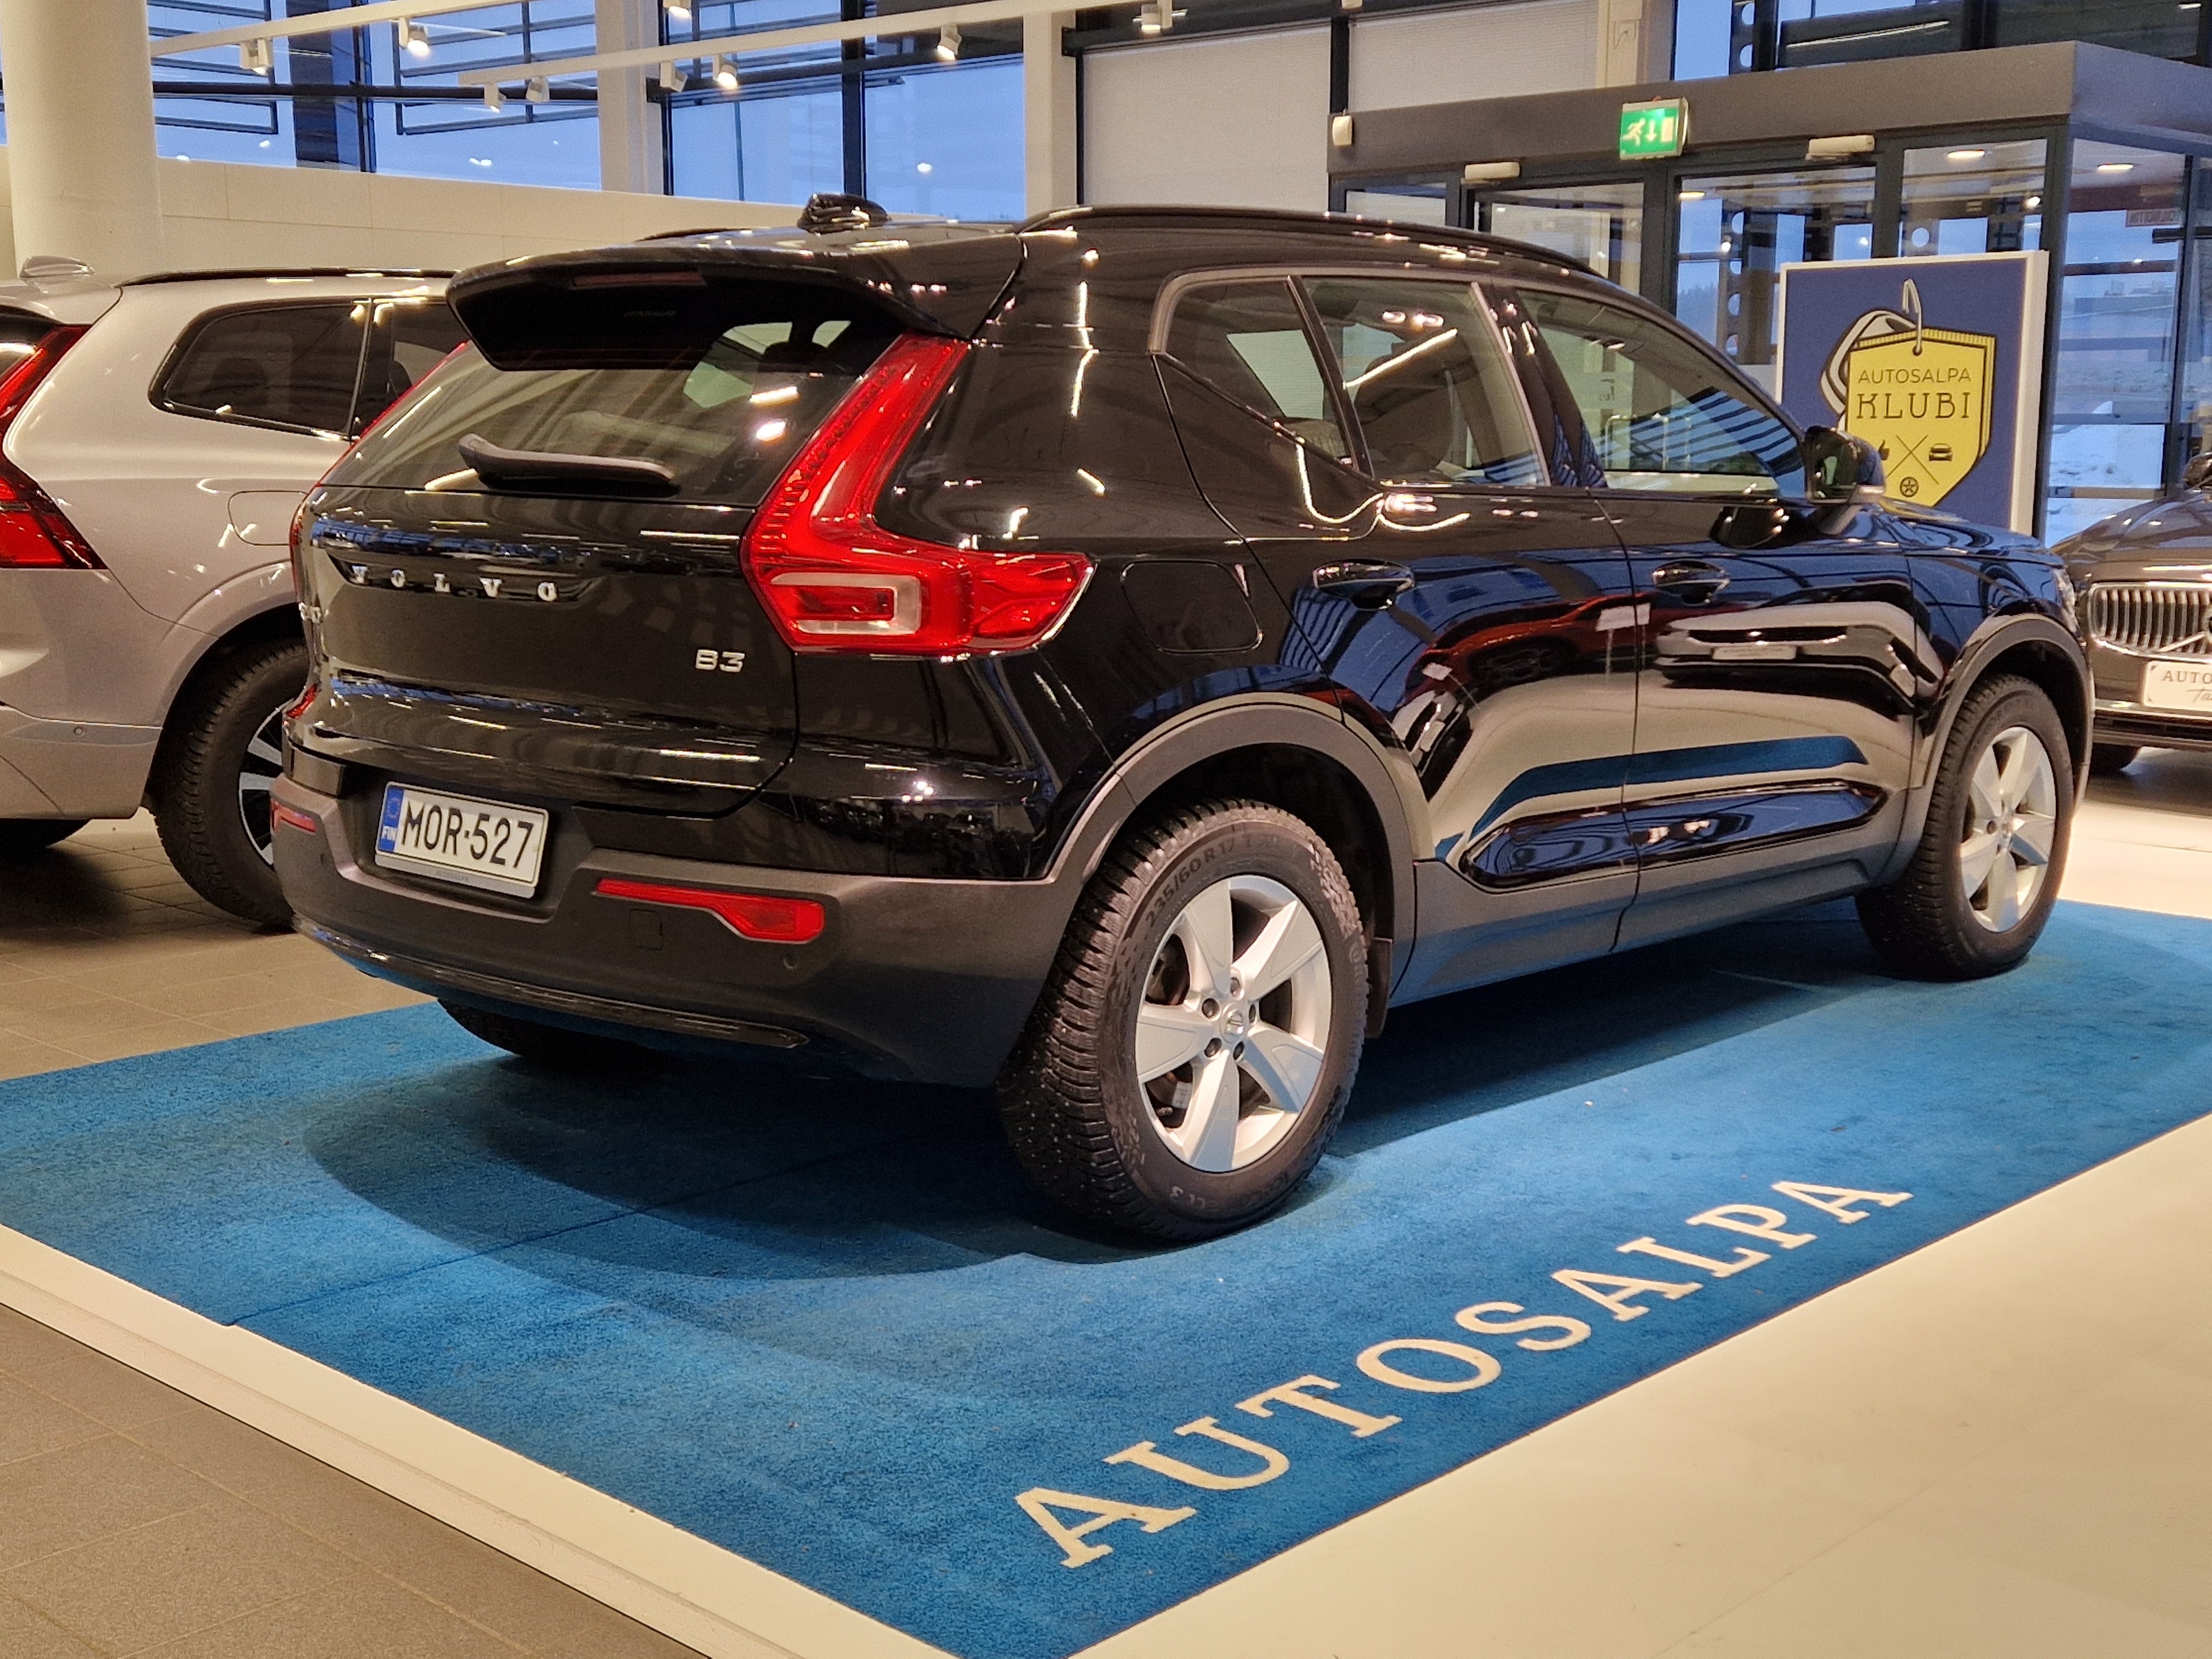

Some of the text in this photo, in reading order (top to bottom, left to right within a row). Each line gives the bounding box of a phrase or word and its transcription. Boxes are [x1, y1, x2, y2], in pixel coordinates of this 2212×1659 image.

[1858, 367, 1971, 384] AUTOSALPA
[1856, 391, 1971, 419] KLUBI
[351, 564, 559, 602] VOLVO
[695, 649, 745, 672] B3
[382, 826, 397, 841] FIN
[1015, 1180, 1913, 1569] AUTOSALPA
